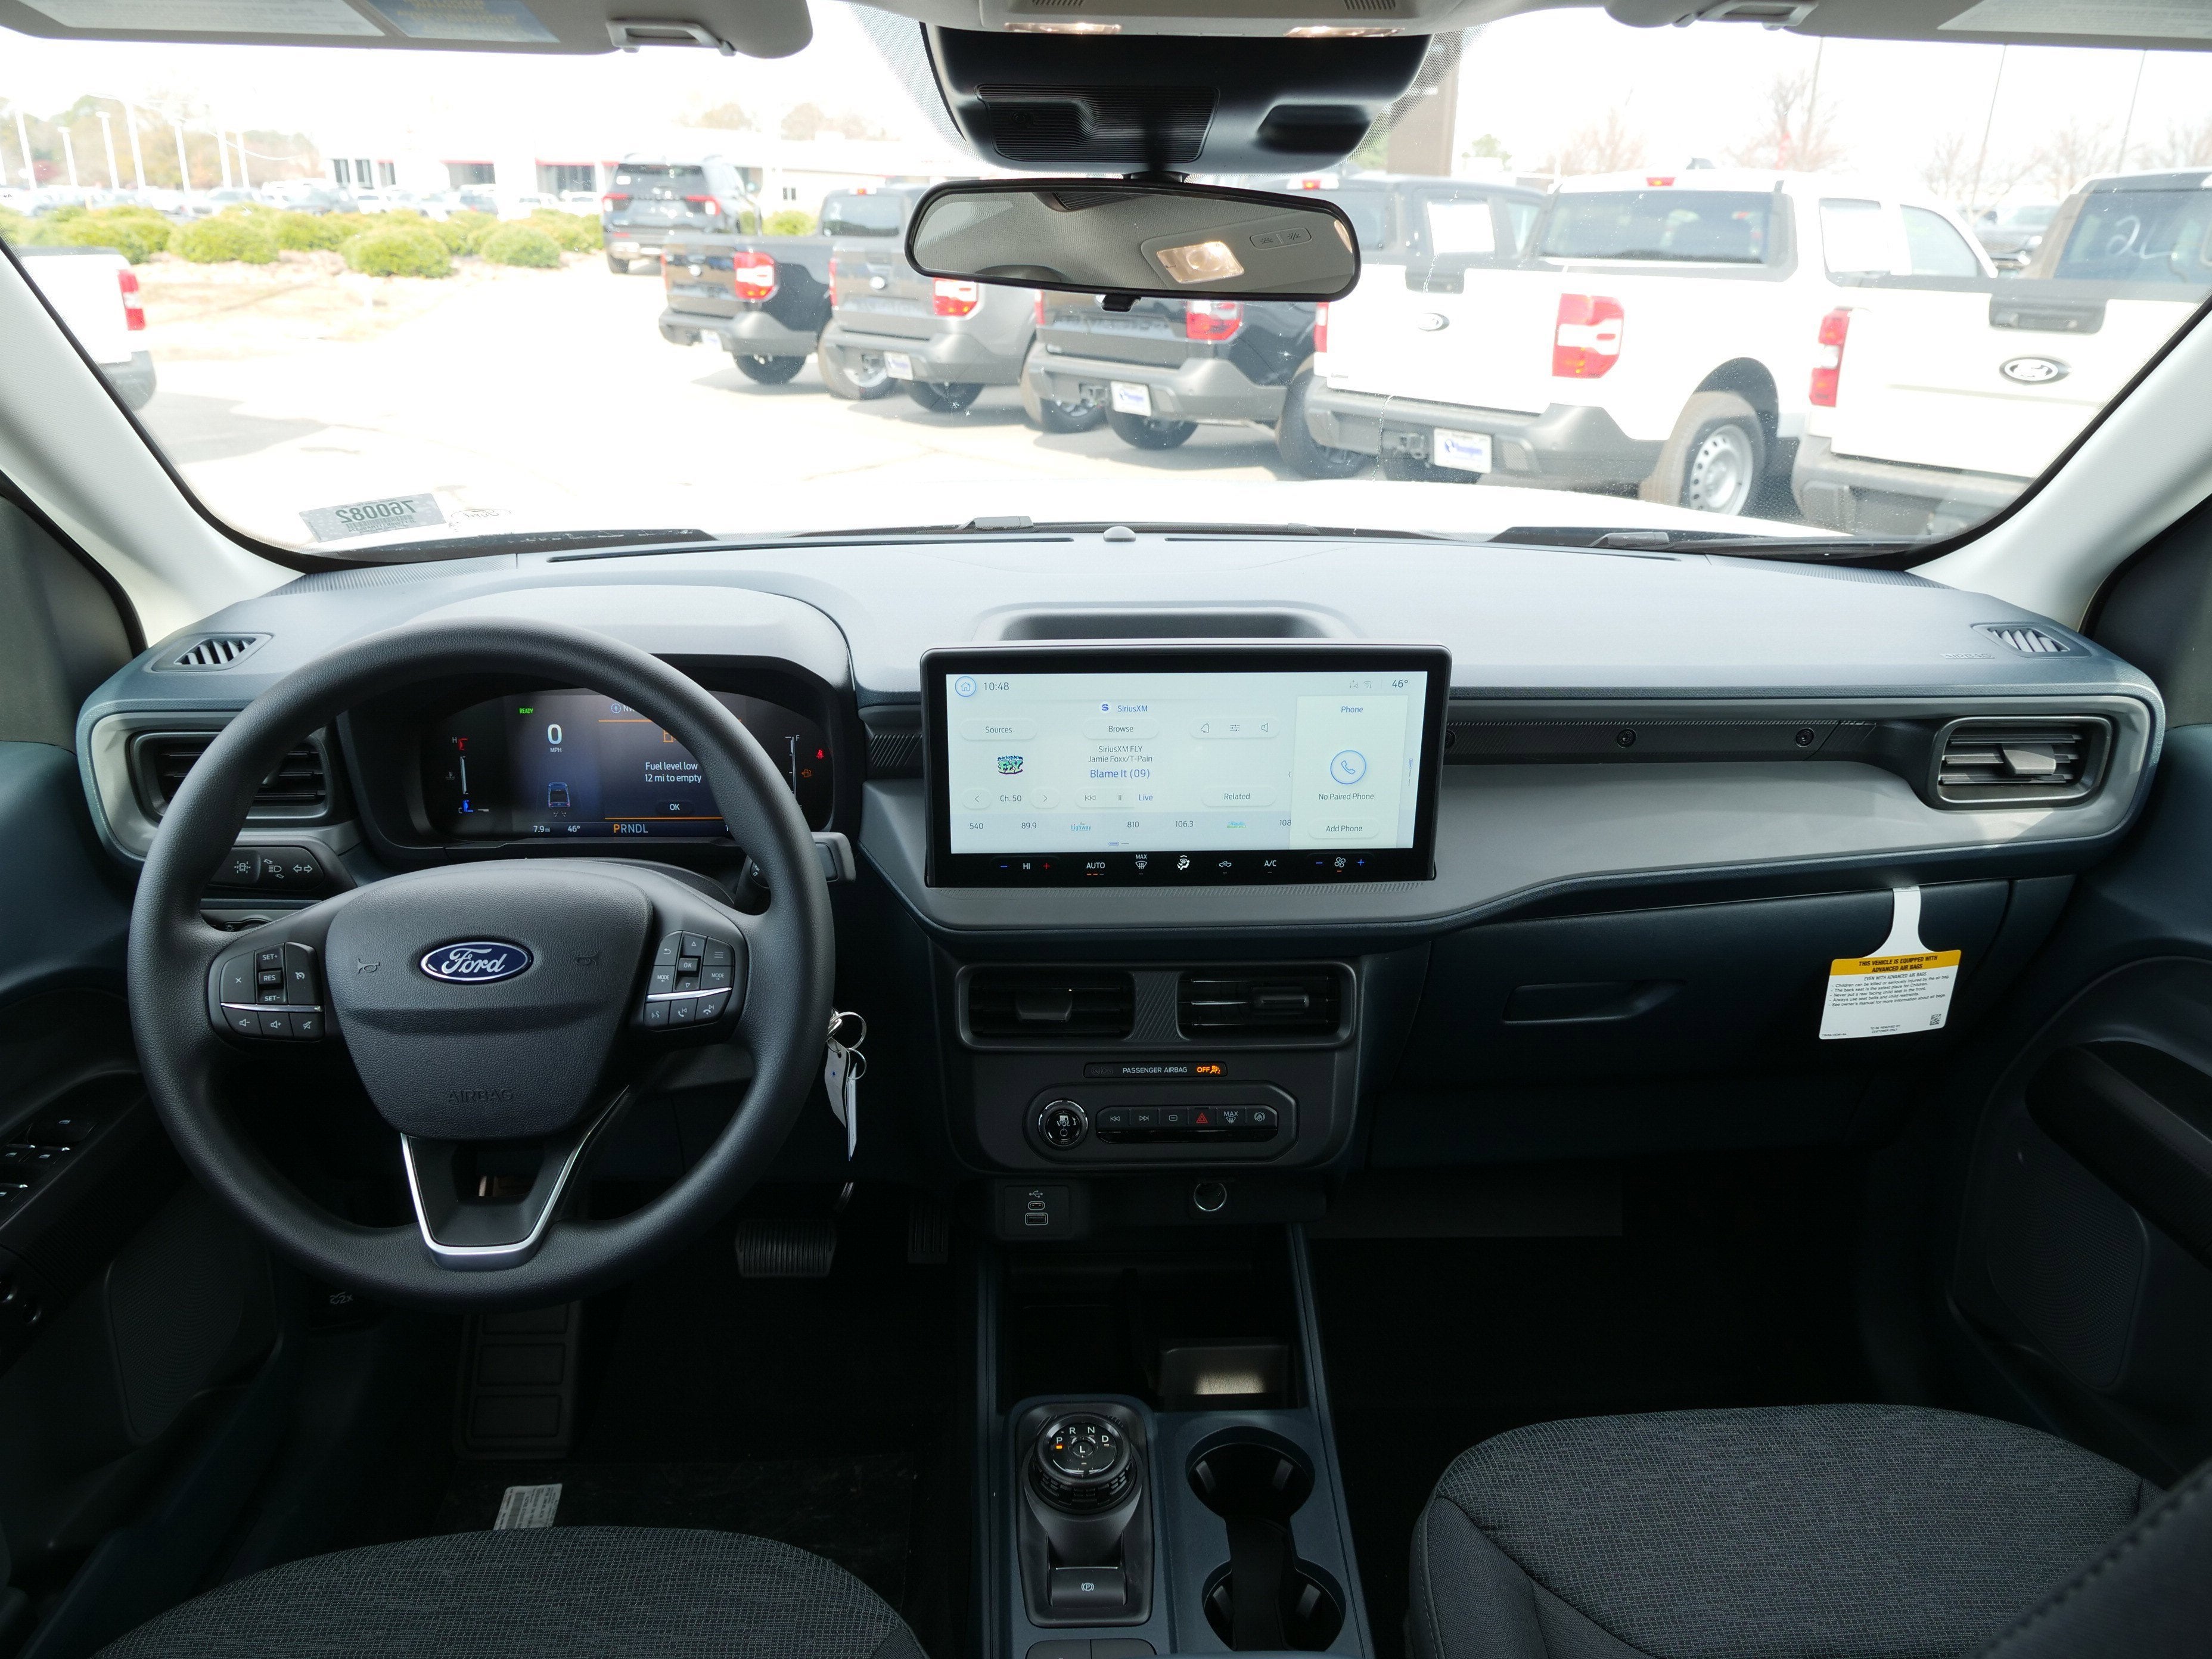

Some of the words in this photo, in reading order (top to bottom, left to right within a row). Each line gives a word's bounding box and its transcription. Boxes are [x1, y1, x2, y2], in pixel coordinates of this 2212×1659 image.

[983, 682, 1010, 691] 10:48
[1392, 679, 1409, 688] 46°
[547, 723, 563, 745] 0
[1110, 754, 1152, 763] Foxx/T-Pain
[645, 762, 663, 771] Fuel
[663, 762, 682, 771] level
[684, 762, 698, 771] low
[1090, 769, 1118, 778] Blame
[1120, 769, 1127, 778] It
[1129, 769, 1151, 779] (09)
[676, 775, 701, 784] empty
[1341, 825, 1362, 833] Phone
[446, 1088, 514, 1103] AIRBAG
